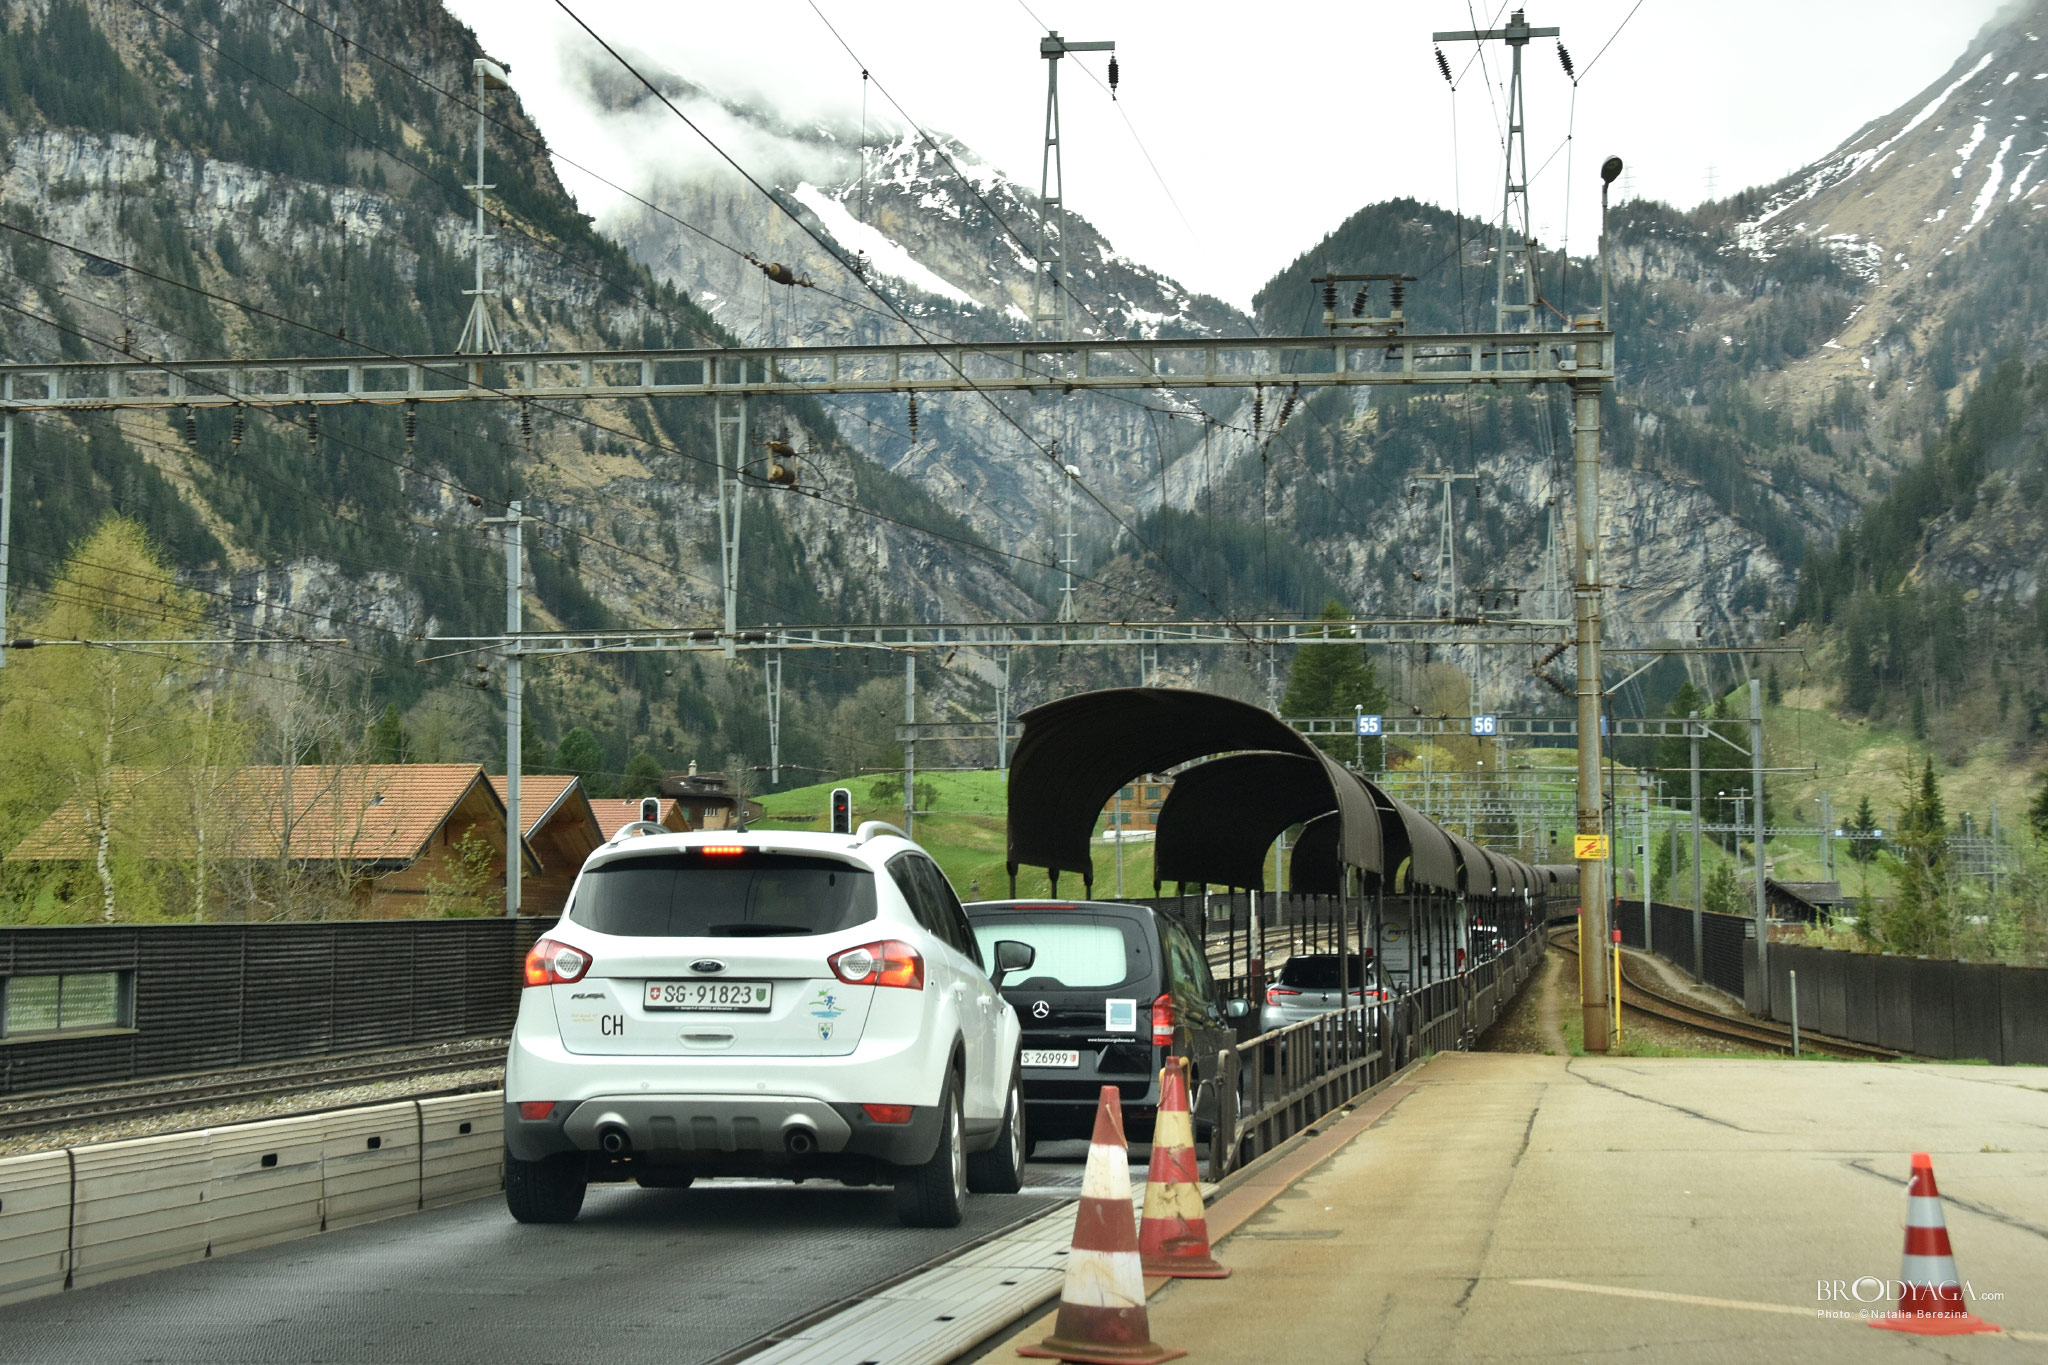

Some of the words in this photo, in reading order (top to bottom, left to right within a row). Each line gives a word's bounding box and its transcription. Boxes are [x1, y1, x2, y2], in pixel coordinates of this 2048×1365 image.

[1360, 717, 1378, 733] 55
[1474, 717, 1493, 733] 56
[601, 1014, 624, 1036] CH
